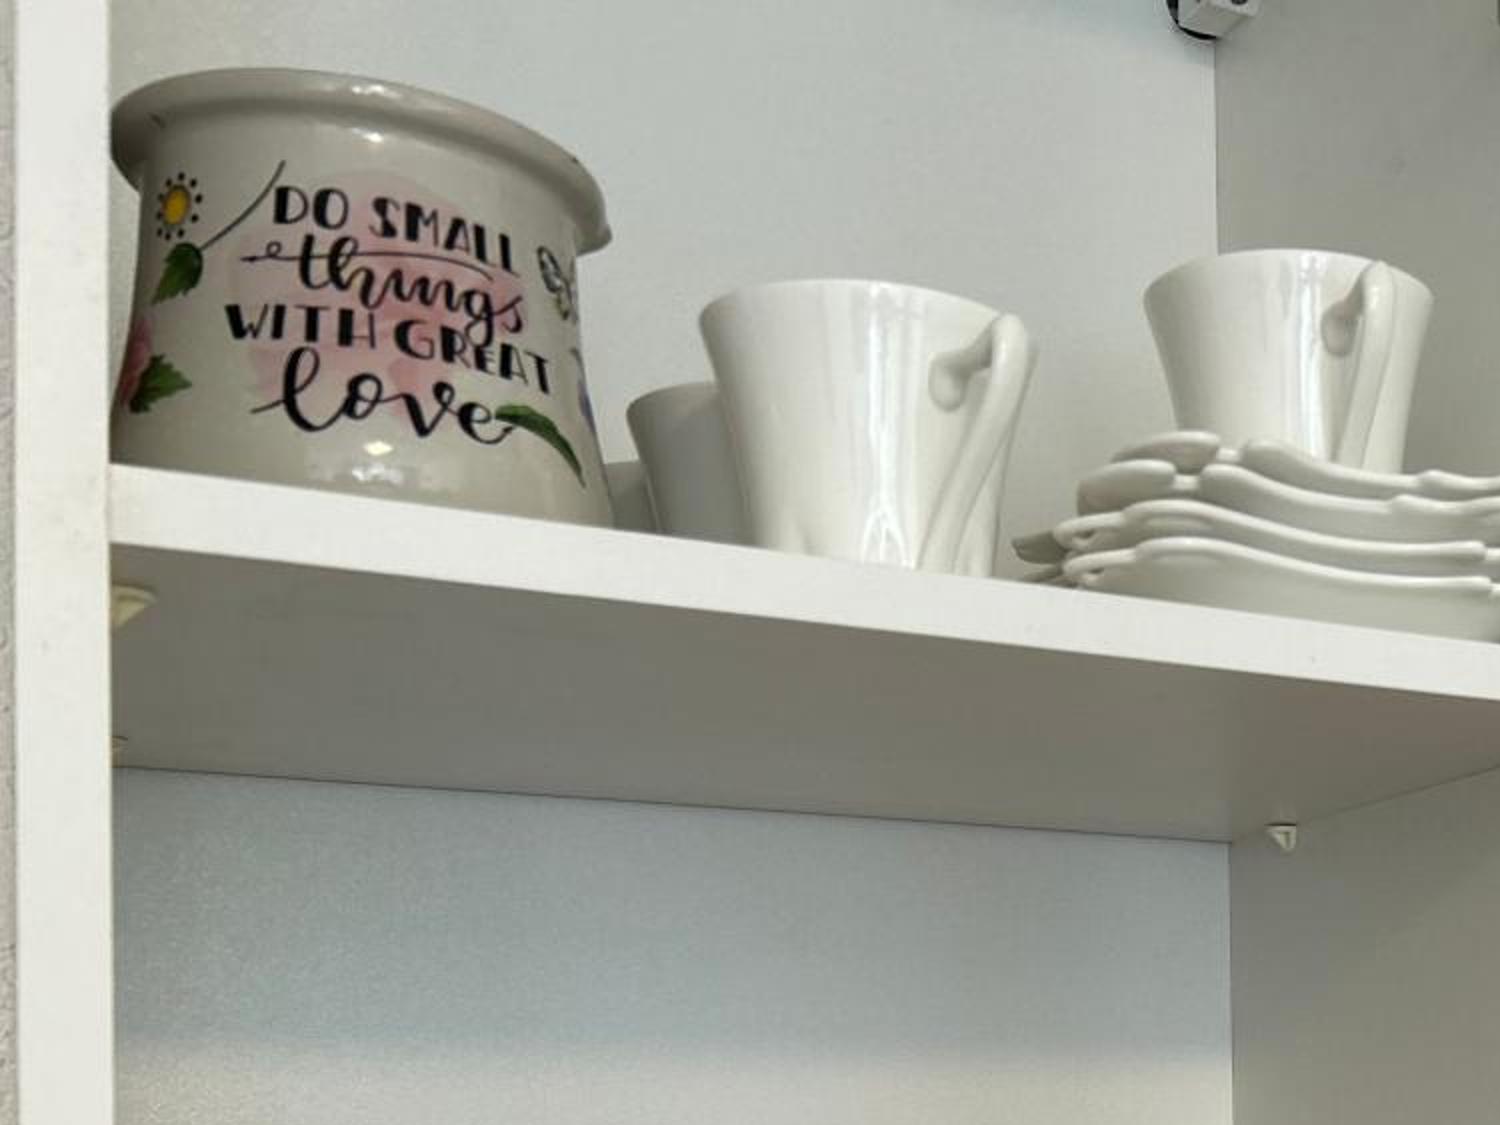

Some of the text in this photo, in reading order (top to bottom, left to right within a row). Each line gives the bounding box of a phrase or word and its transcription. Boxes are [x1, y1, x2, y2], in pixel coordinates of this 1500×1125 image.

[273, 186, 521, 277] DO SMALL
[240, 233, 525, 346] things
[224, 303, 550, 394] WITH GREAT
[250, 346, 515, 446] love
